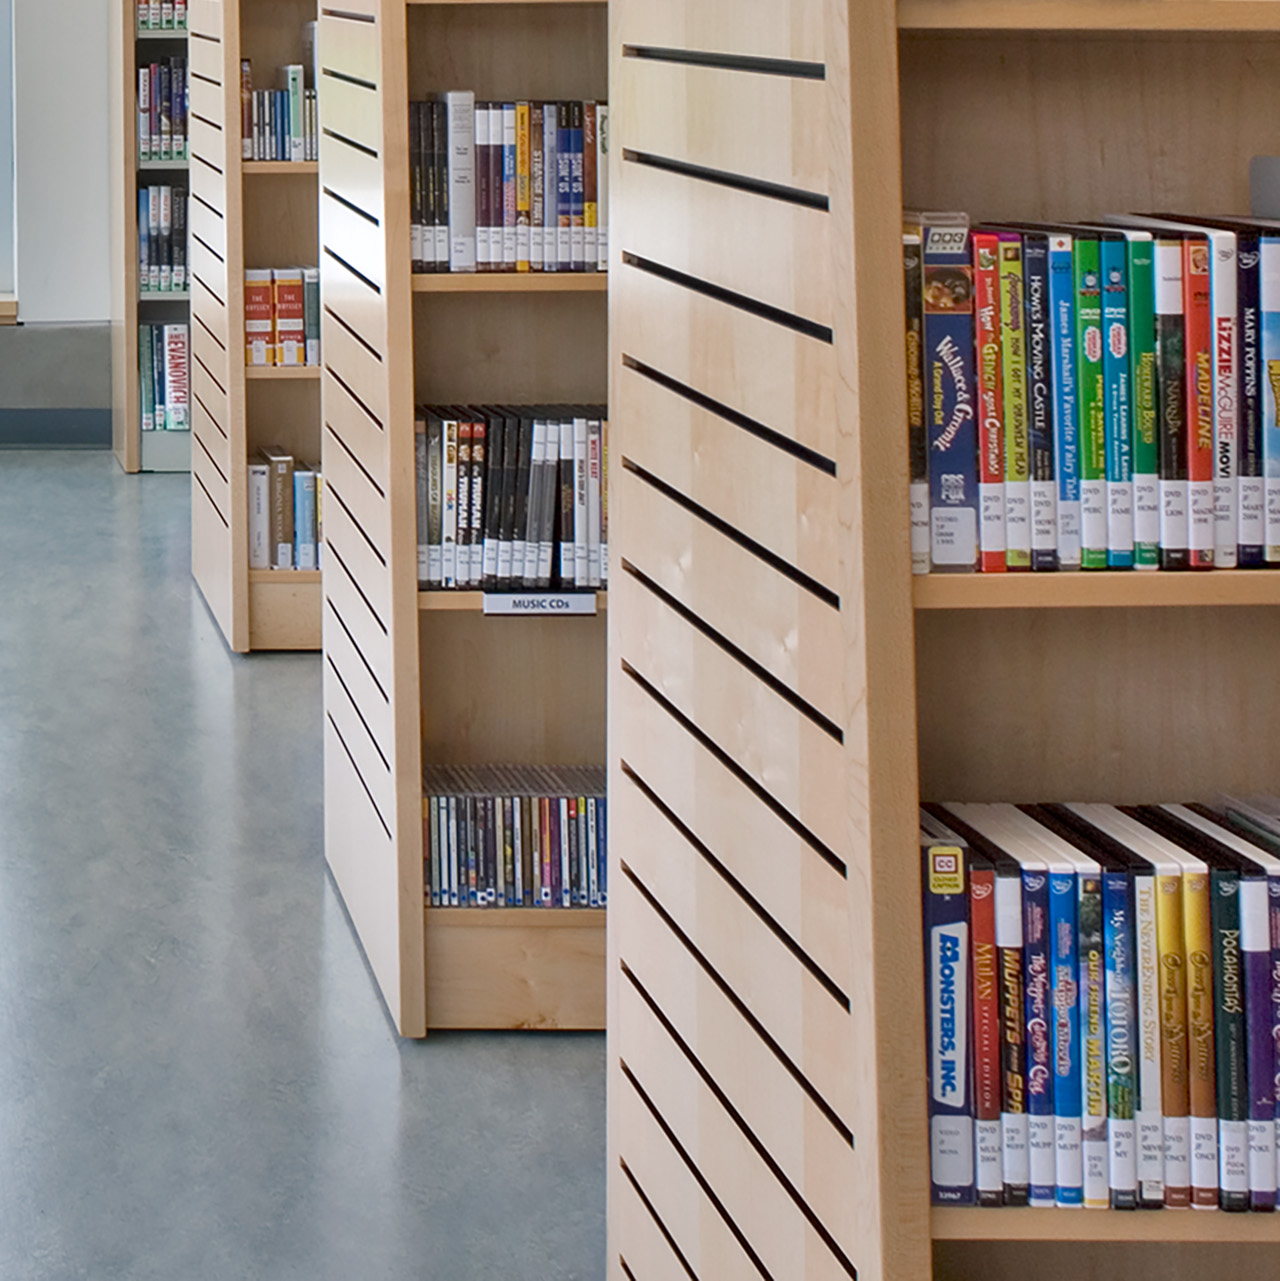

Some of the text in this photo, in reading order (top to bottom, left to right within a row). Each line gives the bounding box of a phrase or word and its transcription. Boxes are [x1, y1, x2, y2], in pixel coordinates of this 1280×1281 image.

[1059, 300, 1071, 334] James
[1244, 307, 1256, 345] MARY
[167, 341, 187, 404] EVANOVICH
[936, 334, 966, 394] Wallace
[982, 343, 998, 389] GRINCH
[1030, 275, 1046, 429] HOWL'S MOVING CASTLE
[1061, 336, 1074, 393] Marshall's
[1244, 347, 1256, 397] POPPINS
[933, 369, 943, 393] Grand
[1011, 367, 1022, 384] GOT
[1012, 386, 1022, 401] MY
[933, 394, 943, 409] Day
[1063, 395, 1075, 441] Favorite
[1165, 379, 1181, 434] NARNIA
[1196, 350, 1212, 449] MADELINE
[1217, 374, 1234, 440] McGUIRE
[933, 403, 974, 452] Gromit
[1119, 405, 1128, 441] LEARNS
[1014, 451, 1026, 476] HEAD
[1061, 445, 1076, 474] Fairy
[1120, 443, 1129, 453] A
[1120, 455, 1129, 482] LESSO
[1218, 441, 1231, 478] MOVI
[457, 477, 468, 528] TRUMAN
[471, 477, 482, 529] TRUMAN
[512, 599, 570, 609] MUSIC CDs
[1139, 887, 1152, 916] THE
[1109, 909, 1131, 1074] My Neighbor TOTORO
[1219, 929, 1242, 1014] POCAHONTAS
[939, 934, 959, 1097] MONSTERS, INC.
[1003, 949, 1021, 1045] MUPPETS
[981, 1005, 990, 1051] SPECIAL
[1088, 950, 1101, 1115] OUR FRIEND MARTIN
[1143, 1020, 1155, 1062] STORY
[983, 1058, 991, 1108] EDITION
[1006, 1072, 1023, 1114] SPA
